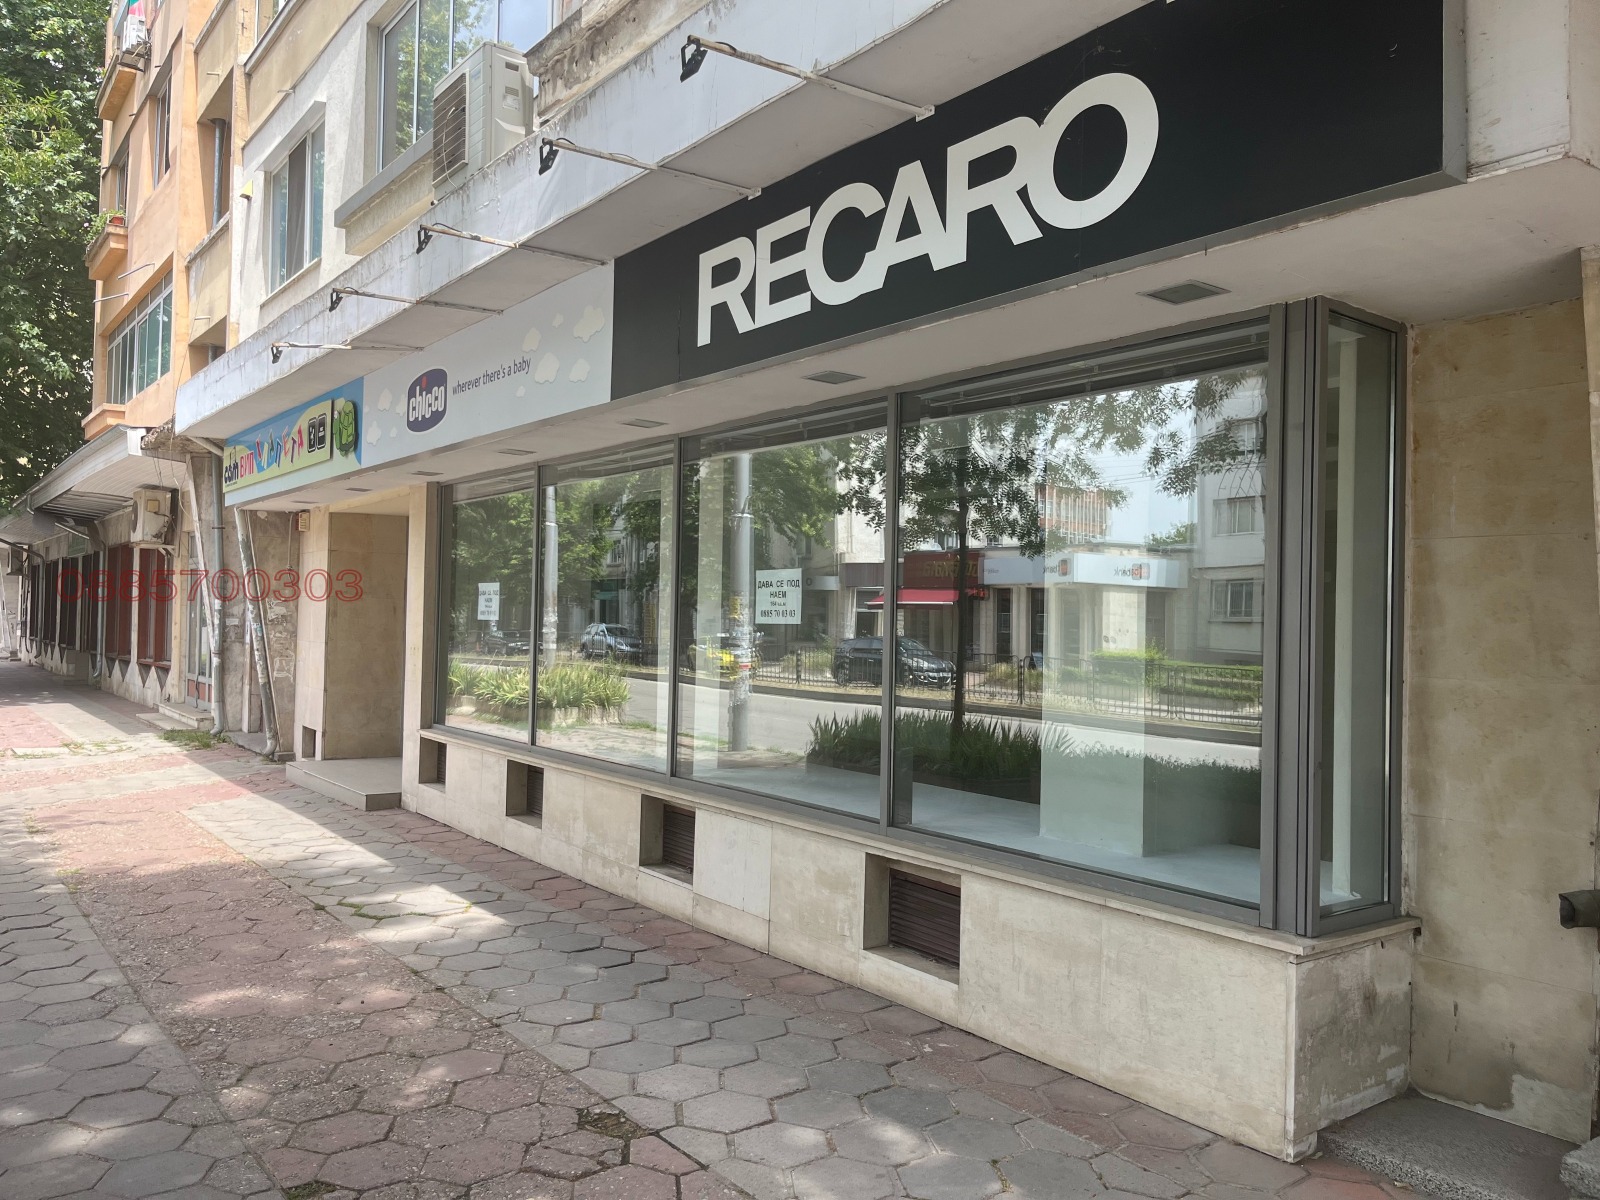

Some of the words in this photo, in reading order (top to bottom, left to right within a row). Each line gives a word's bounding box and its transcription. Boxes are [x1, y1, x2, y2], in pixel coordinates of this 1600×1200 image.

[697, 72, 1160, 348] RECARO
[452, 376, 482, 396] wherever
[482, 365, 506, 385] there's
[507, 366, 512, 375] a
[513, 356, 532, 375] baby
[408, 376, 445, 422] chicco
[758, 580, 773, 589] ДАВА
[776, 580, 784, 588] СЕ
[787, 579, 800, 588] ПОД
[770, 591, 787, 599] НАЕМ
